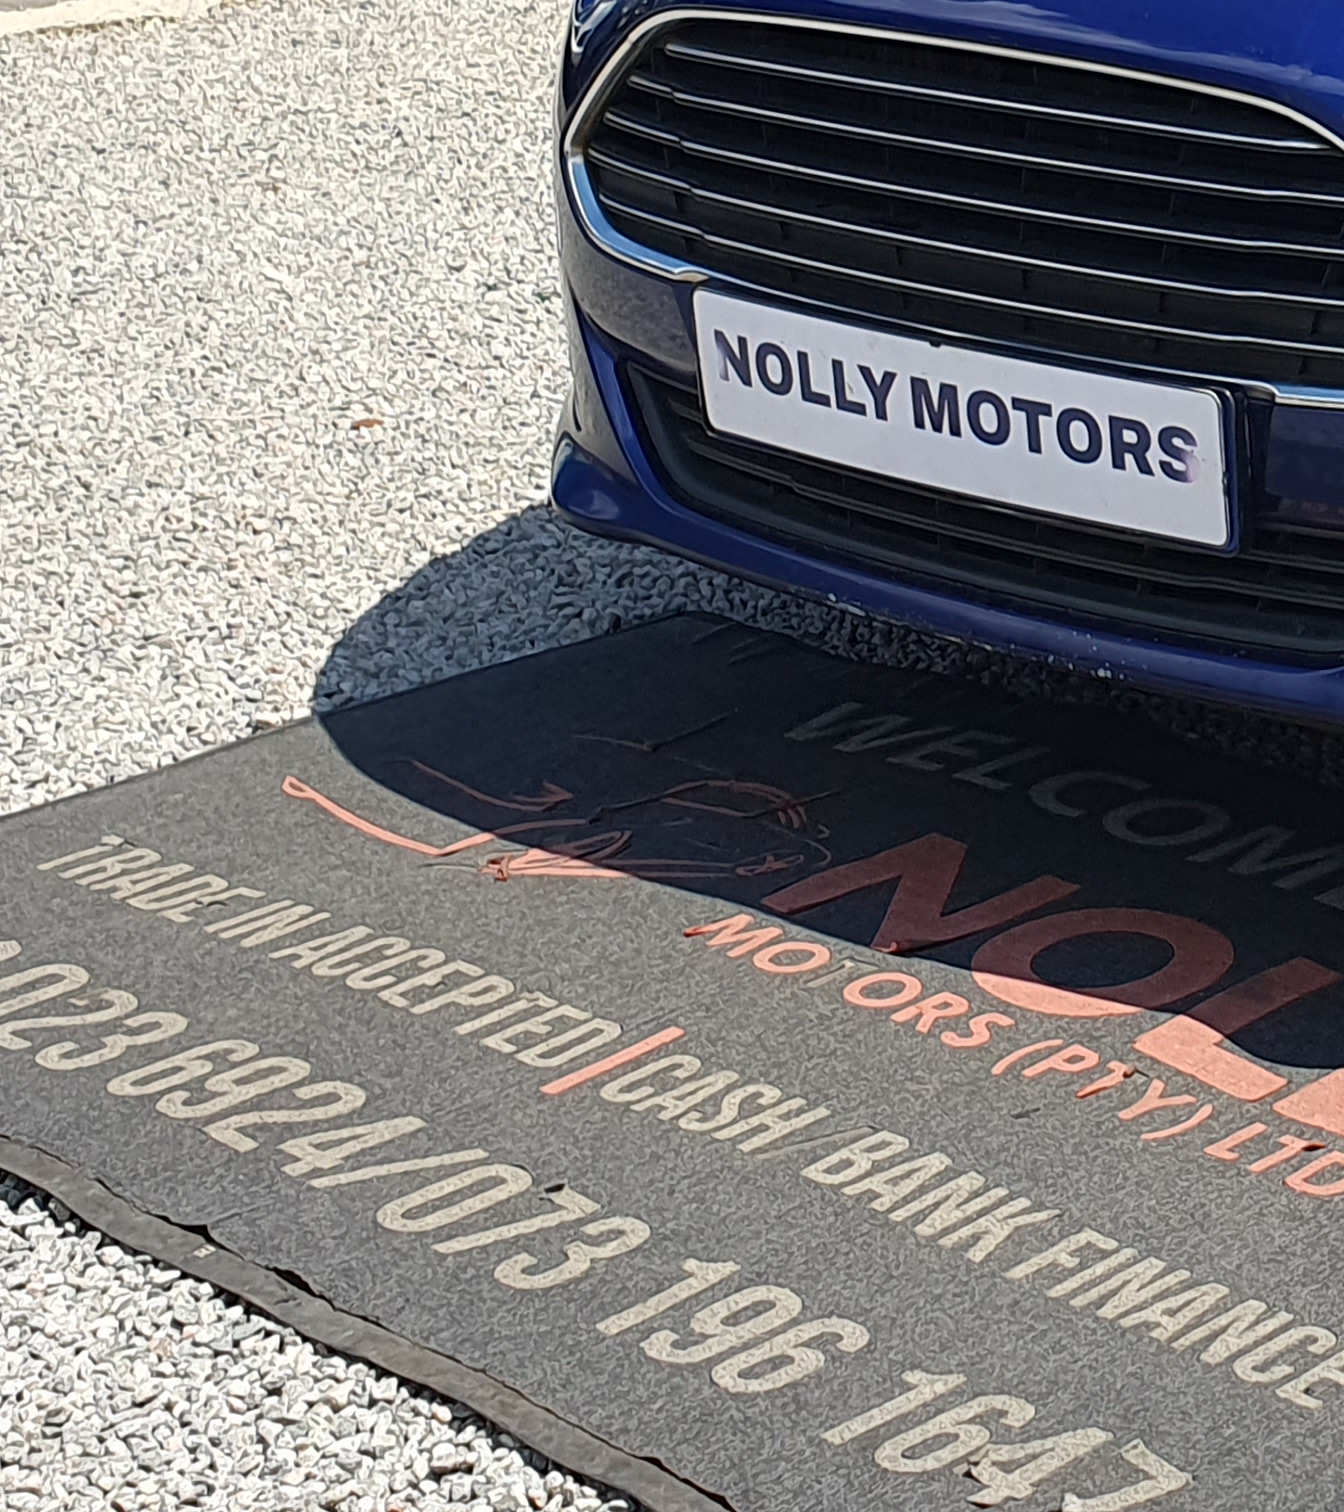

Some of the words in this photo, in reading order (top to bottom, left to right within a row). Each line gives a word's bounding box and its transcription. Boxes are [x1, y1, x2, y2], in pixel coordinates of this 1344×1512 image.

[712, 328, 897, 422] NOLLY
[909, 377, 1201, 484] MOTORS
[36, 834, 266, 923] TRADE
[204, 900, 332, 948] IN
[684, 912, 1015, 1050] MOTORS
[991, 1038, 1214, 1141] (PTY)
[596, 1256, 871, 1394] 196
[820, 1368, 1194, 1512] 1647
